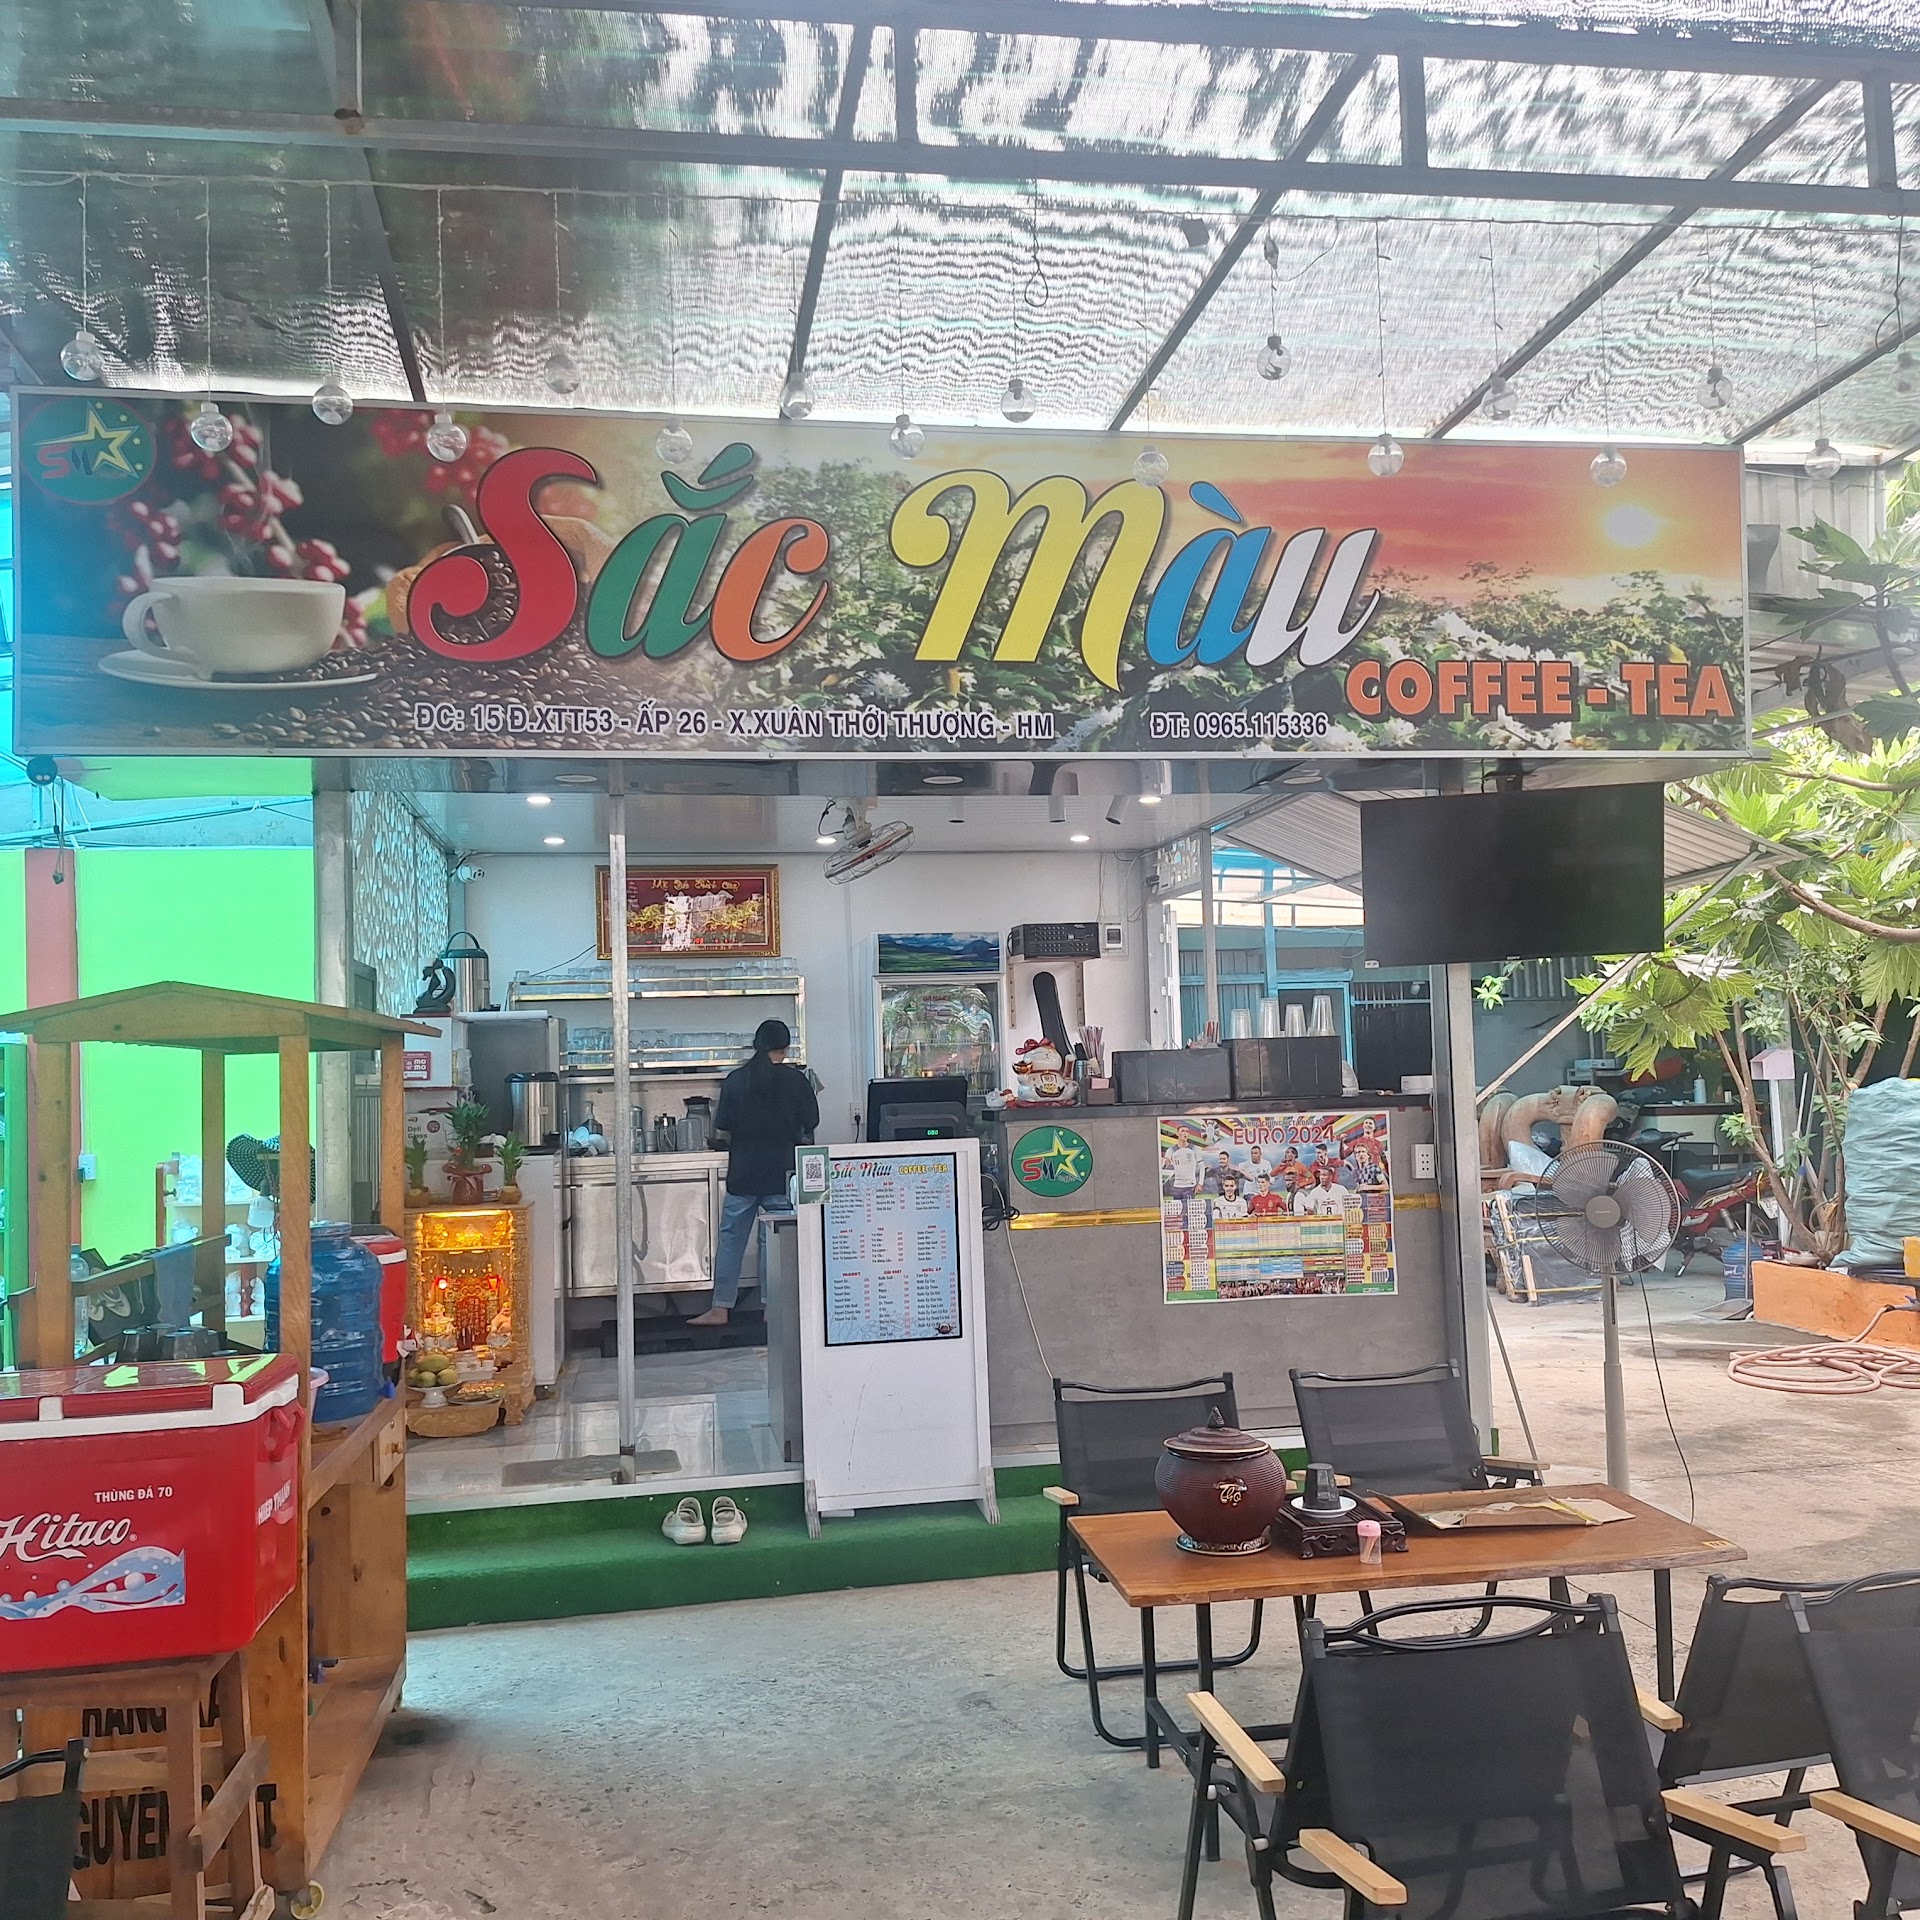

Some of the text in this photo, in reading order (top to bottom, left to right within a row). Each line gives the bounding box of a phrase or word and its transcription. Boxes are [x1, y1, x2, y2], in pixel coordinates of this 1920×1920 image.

[407, 443, 1382, 692] Sắc Màu
[1344, 659, 1576, 718] COFFEE
[1621, 663, 1736, 719] TEA
[416, 703, 464, 731] ĐC:
[472, 704, 502, 732] 15
[507, 704, 614, 735] Đ.XTT53
[636, 698, 670, 734] ẤP
[677, 710, 707, 735] 26
[729, 705, 823, 738] X.XUÂN
[829, 706, 889, 739] THỚI
[891, 708, 996, 744] THƯỢNG
[1017, 712, 1055, 740] HM
[1150, 711, 1329, 739] ĐT: 0965.115336
[1233, 1125, 1336, 1146] EURO 2024
[898, 1164, 928, 1176] COFFEE
[933, 1163, 949, 1174] TEA
[1020, 1157, 1056, 1182] SM
[94, 1485, 173, 1504] THÙNG ĐÁ 70
[0, 1512, 132, 1562] Hitaco
